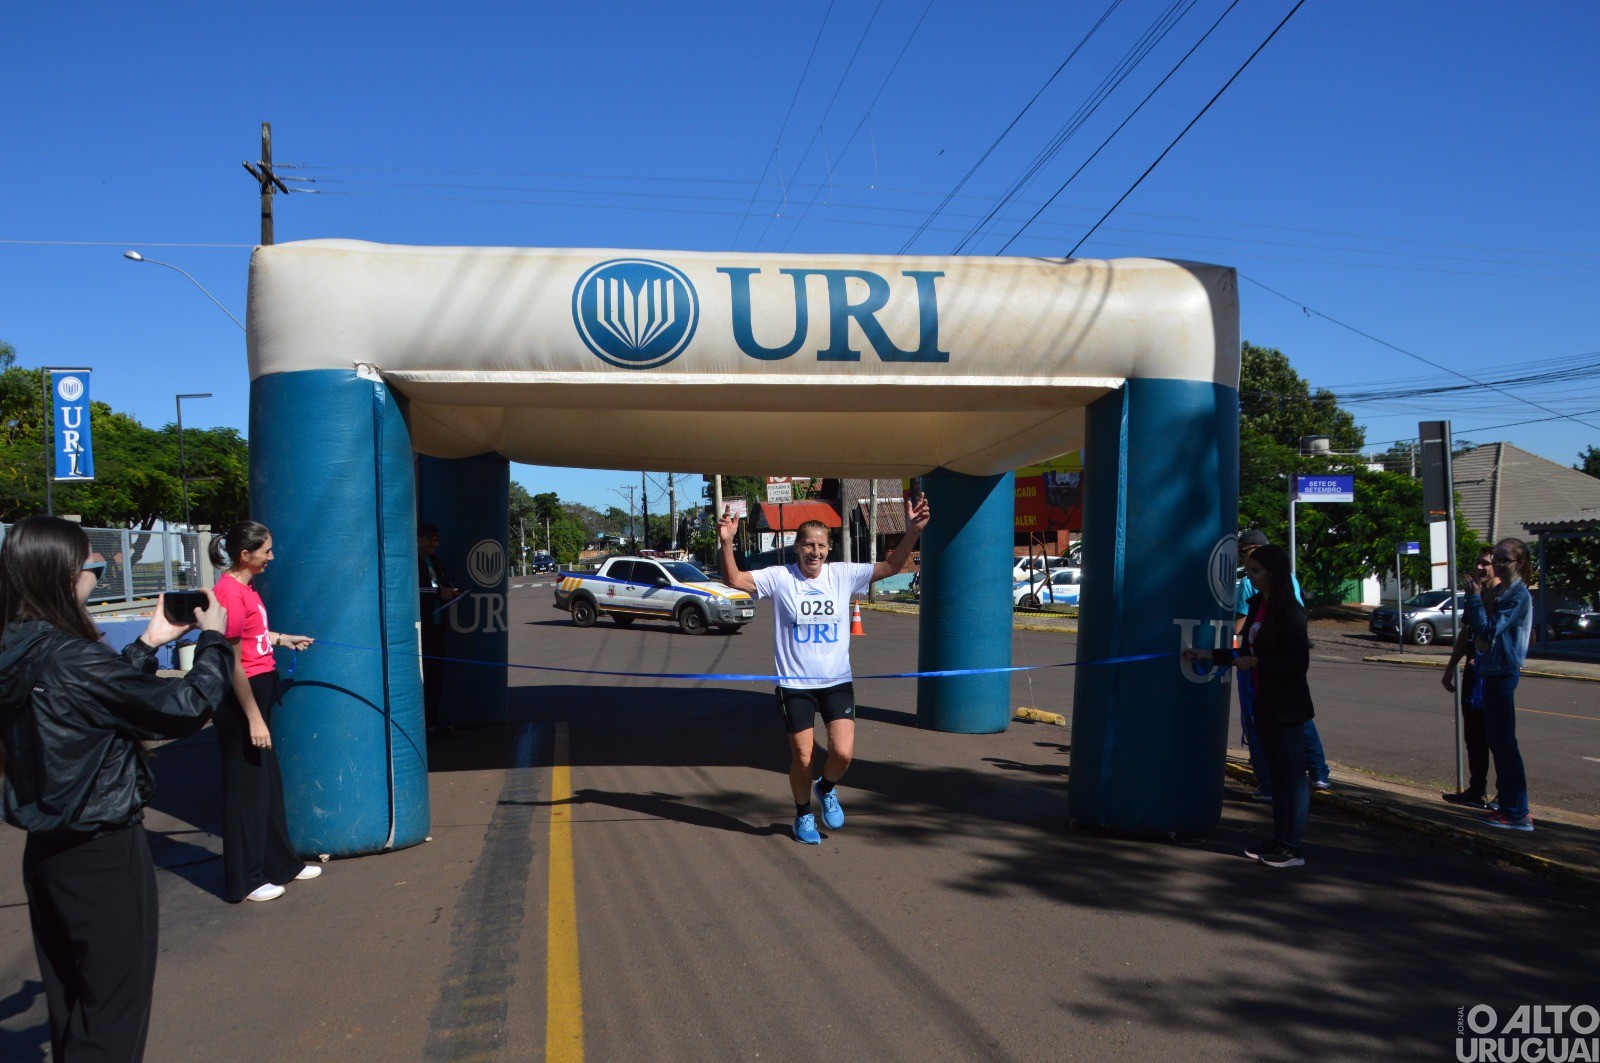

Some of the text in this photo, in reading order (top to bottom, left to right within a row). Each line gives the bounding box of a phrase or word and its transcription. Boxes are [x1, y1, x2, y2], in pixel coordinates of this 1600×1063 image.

[716, 267, 950, 362] URI
[61, 406, 84, 476] URI
[449, 593, 509, 634] UR
[800, 600, 834, 616] 028
[792, 622, 839, 644] URI
